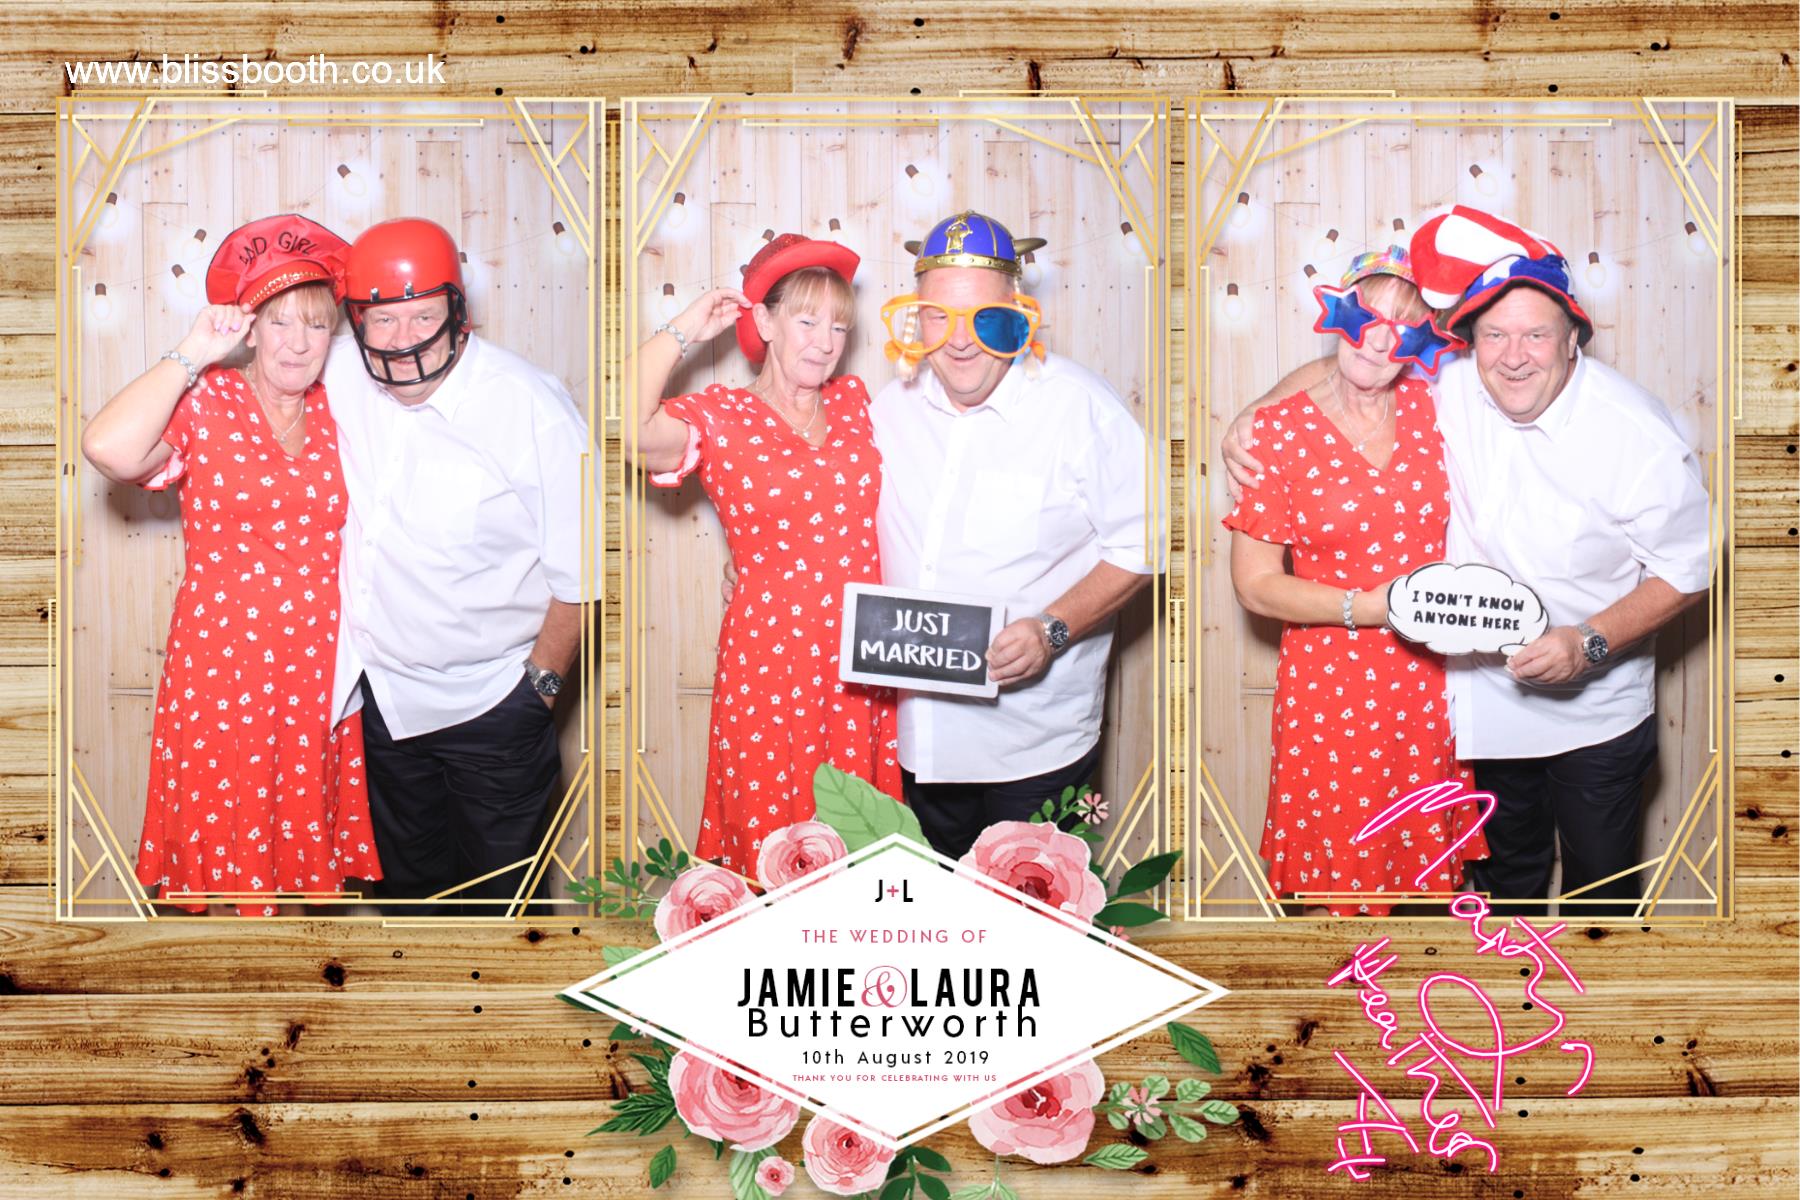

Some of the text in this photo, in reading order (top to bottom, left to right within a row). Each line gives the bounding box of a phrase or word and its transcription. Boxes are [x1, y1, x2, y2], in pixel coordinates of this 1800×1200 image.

[278, 231, 318, 256] GIRL
[1412, 590, 1525, 612] I DON'T KNOW
[891, 609, 951, 636] JUST
[1413, 610, 1520, 631] ANYONE HERE
[860, 639, 982, 671] MARRIED
